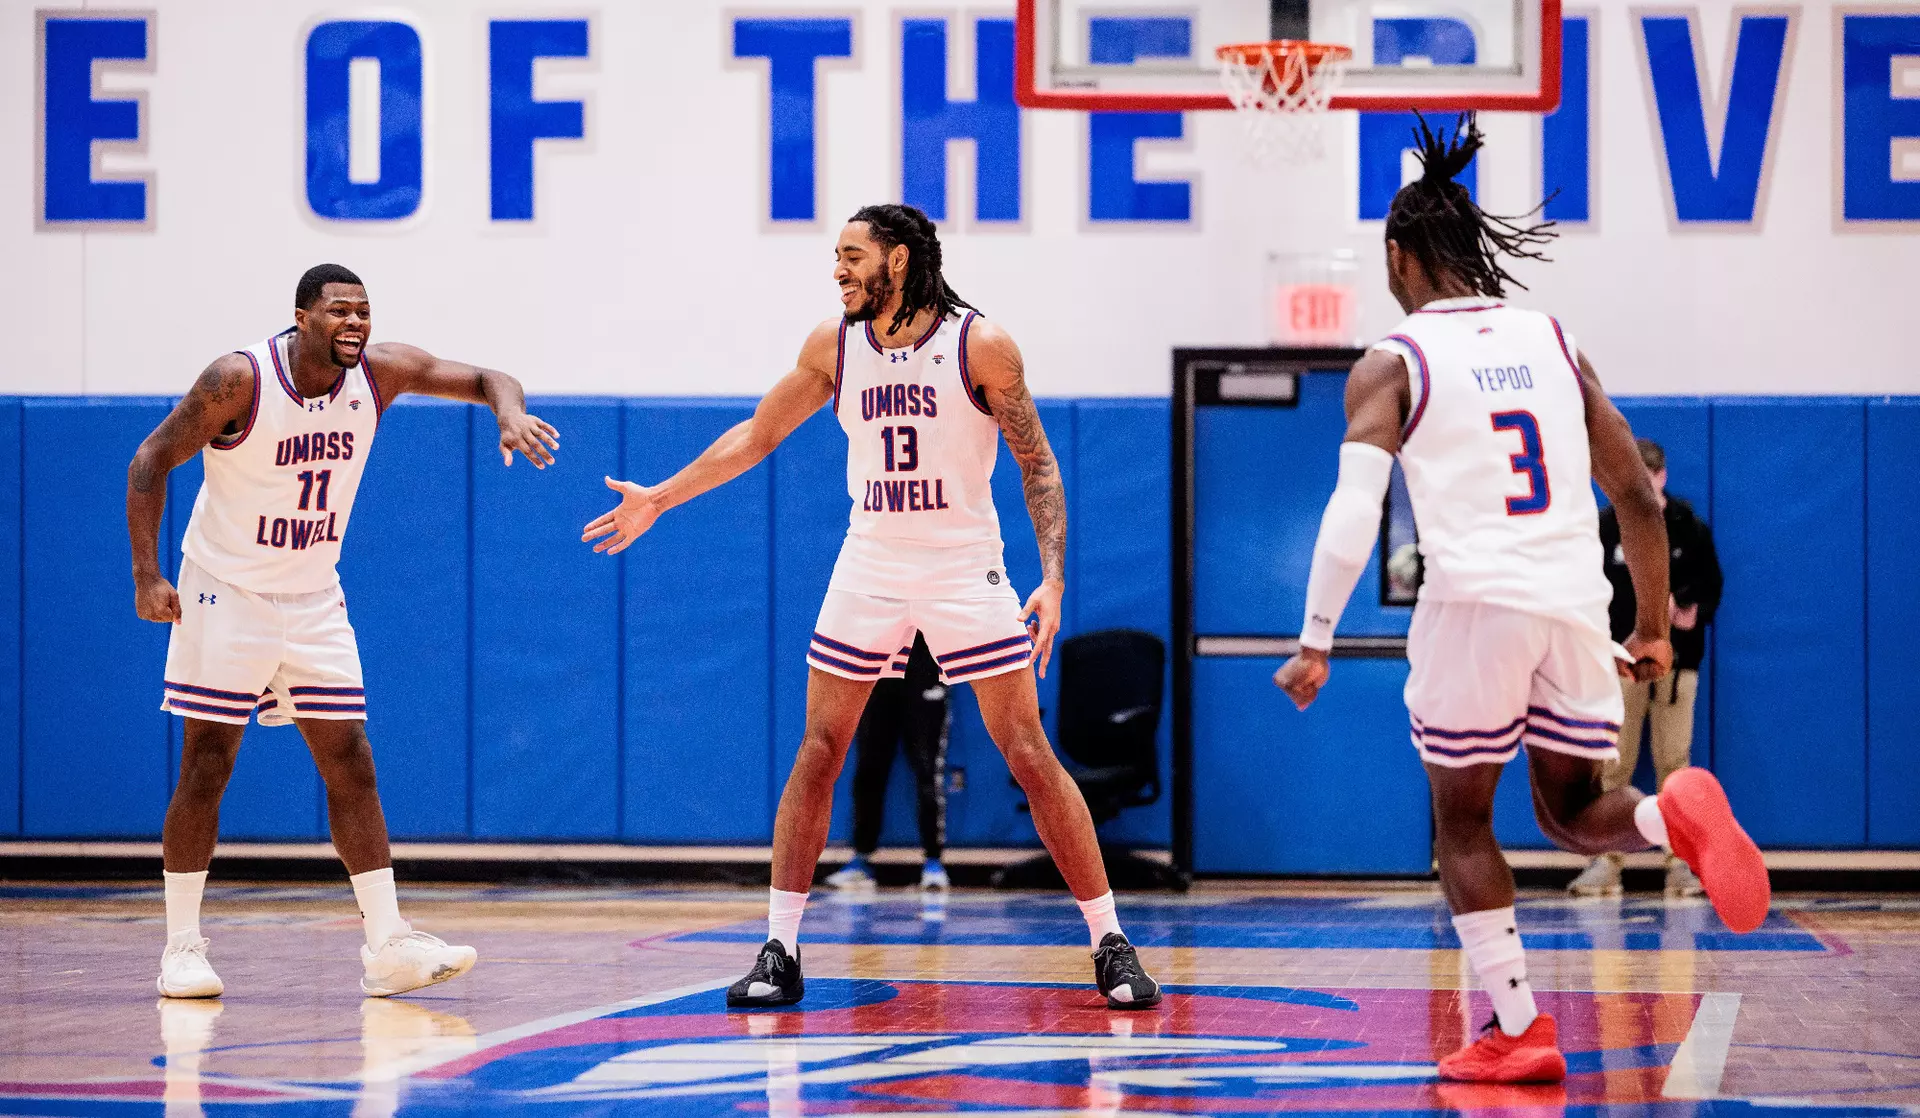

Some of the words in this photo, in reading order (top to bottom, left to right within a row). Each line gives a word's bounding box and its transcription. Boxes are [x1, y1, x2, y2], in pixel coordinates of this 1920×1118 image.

[45, 19, 148, 222] E
[305, 19, 590, 222] OF
[733, 19, 1191, 222] THE
[1358, 17, 1920, 222] RIVE
[1290, 292, 1343, 331] EXIT
[861, 383, 938, 421] UMASS
[275, 431, 354, 467] UMASS
[881, 426, 919, 472] 13
[1490, 409, 1552, 516] 3
[297, 469, 332, 511] 11
[863, 478, 949, 513] LOWELL
